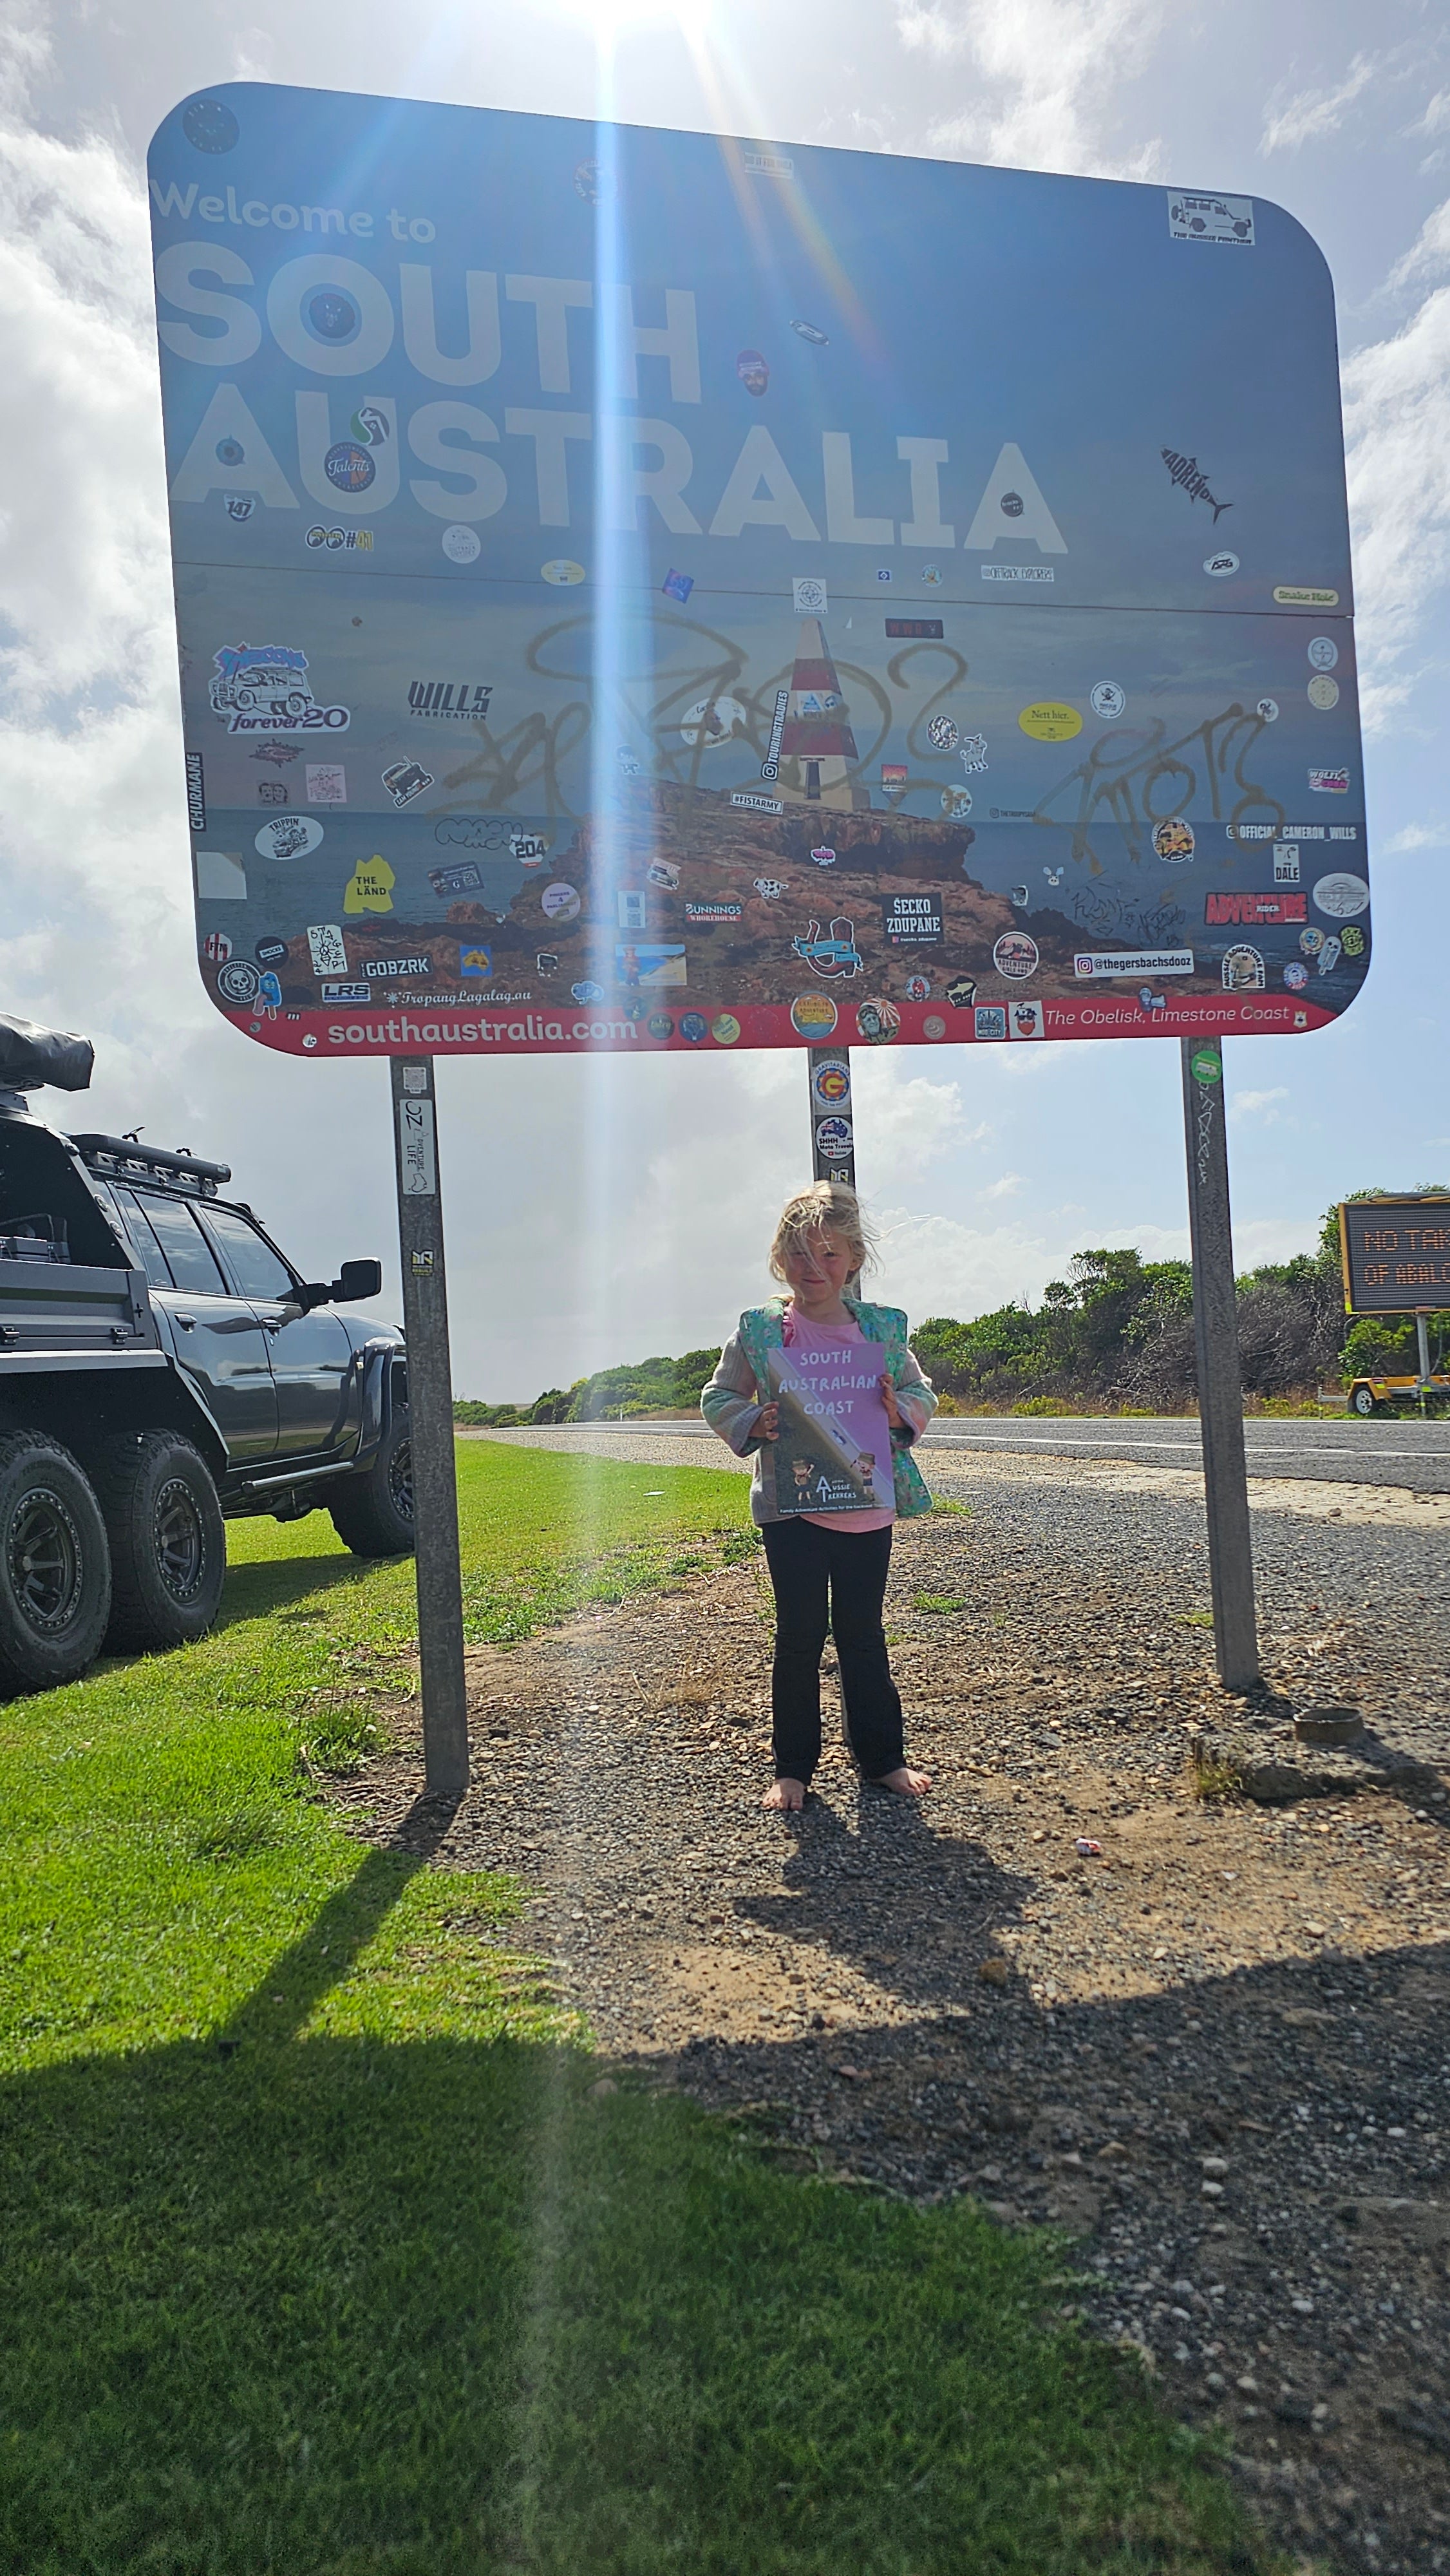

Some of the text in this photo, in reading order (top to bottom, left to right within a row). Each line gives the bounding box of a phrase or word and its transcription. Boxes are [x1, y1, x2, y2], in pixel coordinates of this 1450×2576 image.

[148, 178, 436, 243] Welcome to
[155, 241, 702, 404] SOUTH
[170, 383, 1069, 554] AUSTRALIA
[328, 458, 372, 475] Talents
[1165, 452, 1210, 499] ADRENO
[227, 500, 252, 516] 147
[346, 529, 373, 551] #41
[1278, 589, 1335, 602] Snake Hole
[408, 681, 493, 713] WILLS
[229, 708, 348, 733] forever20
[410, 710, 487, 721] FABRICATION
[1031, 710, 1069, 719] Nett hier.
[767, 691, 787, 763] TOURINGTRADIES
[734, 795, 779, 810] #FISTARMY
[268, 817, 299, 831] TRIPPIN
[515, 839, 547, 858] 204
[1276, 867, 1299, 880] DALE
[357, 886, 386, 895] LÄND
[686, 904, 741, 915] BUNNINGS
[893, 897, 930, 914] ŠECKO
[1205, 893, 1308, 925] ADVENTURE
[887, 917, 941, 933] ZDUPANE
[366, 958, 429, 977] GOBZRK
[998, 959, 1031, 969] ADVENTURE
[1095, 956, 1191, 972] @thegersbachsdooz
[324, 984, 370, 996] LRS
[1046, 1006, 1290, 1025] The Obelisk, Limestone Coast
[328, 1015, 638, 1043] southaustralia.com
[406, 1101, 423, 1130] OZ
[407, 1145, 417, 1165] LIFE
[1364, 1231, 1398, 1251] NO
[1364, 1264, 1389, 1285] OF
[800, 1349, 852, 1367] SOUTH
[778, 1374, 877, 1394] AUSTRALIAN
[803, 1400, 854, 1416] COAST
